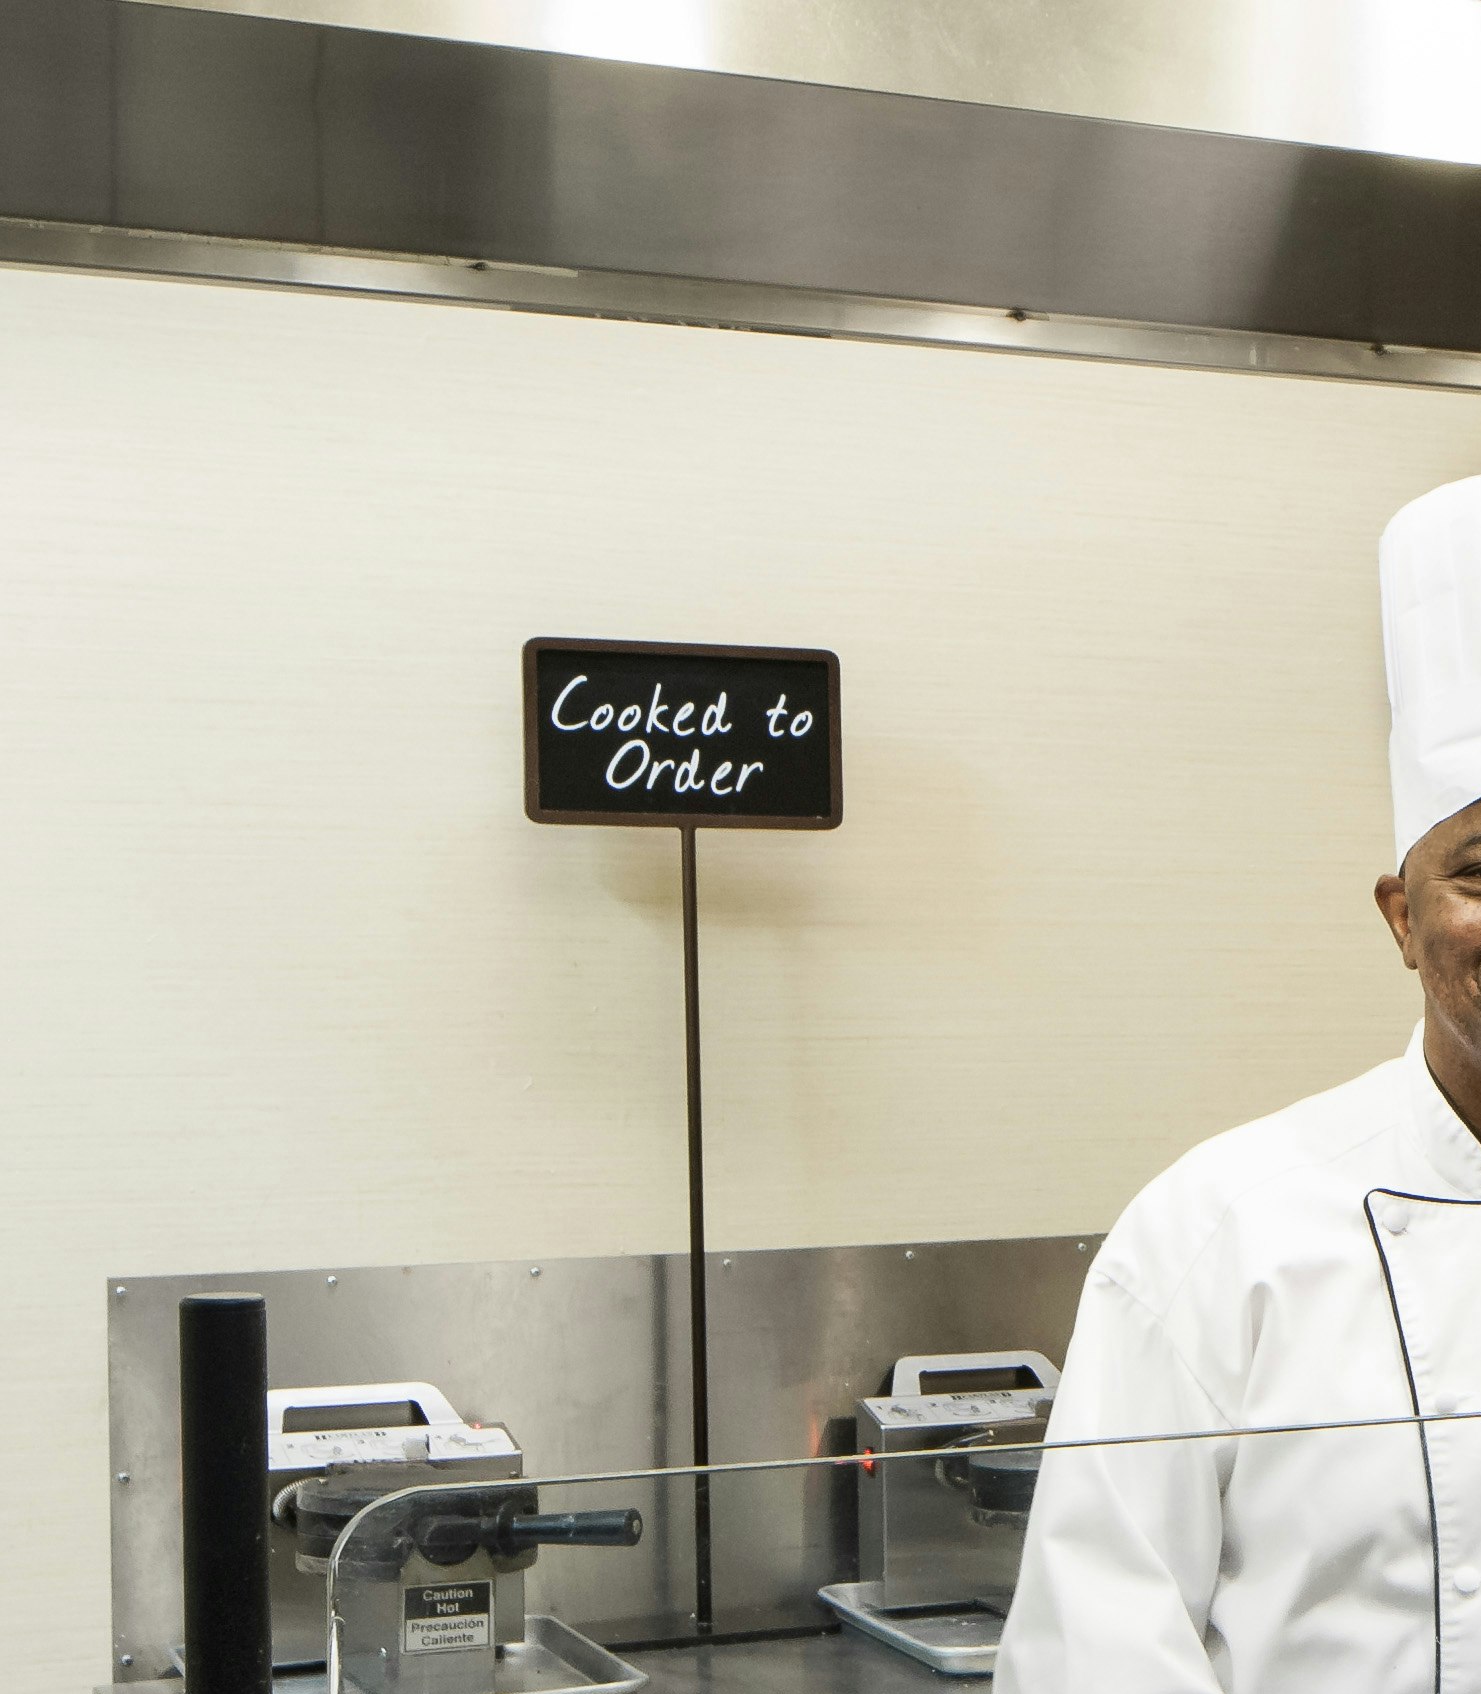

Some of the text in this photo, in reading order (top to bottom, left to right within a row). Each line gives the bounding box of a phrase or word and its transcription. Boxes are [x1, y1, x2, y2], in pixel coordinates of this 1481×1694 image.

[552, 675, 812, 737] Cooked to
[606, 740, 763, 795] Order
[422, 1588, 474, 1602] Caution
[436, 1603, 459, 1615] Hot
[411, 1619, 484, 1634] Precaución
[421, 1633, 474, 1647] Caliente
